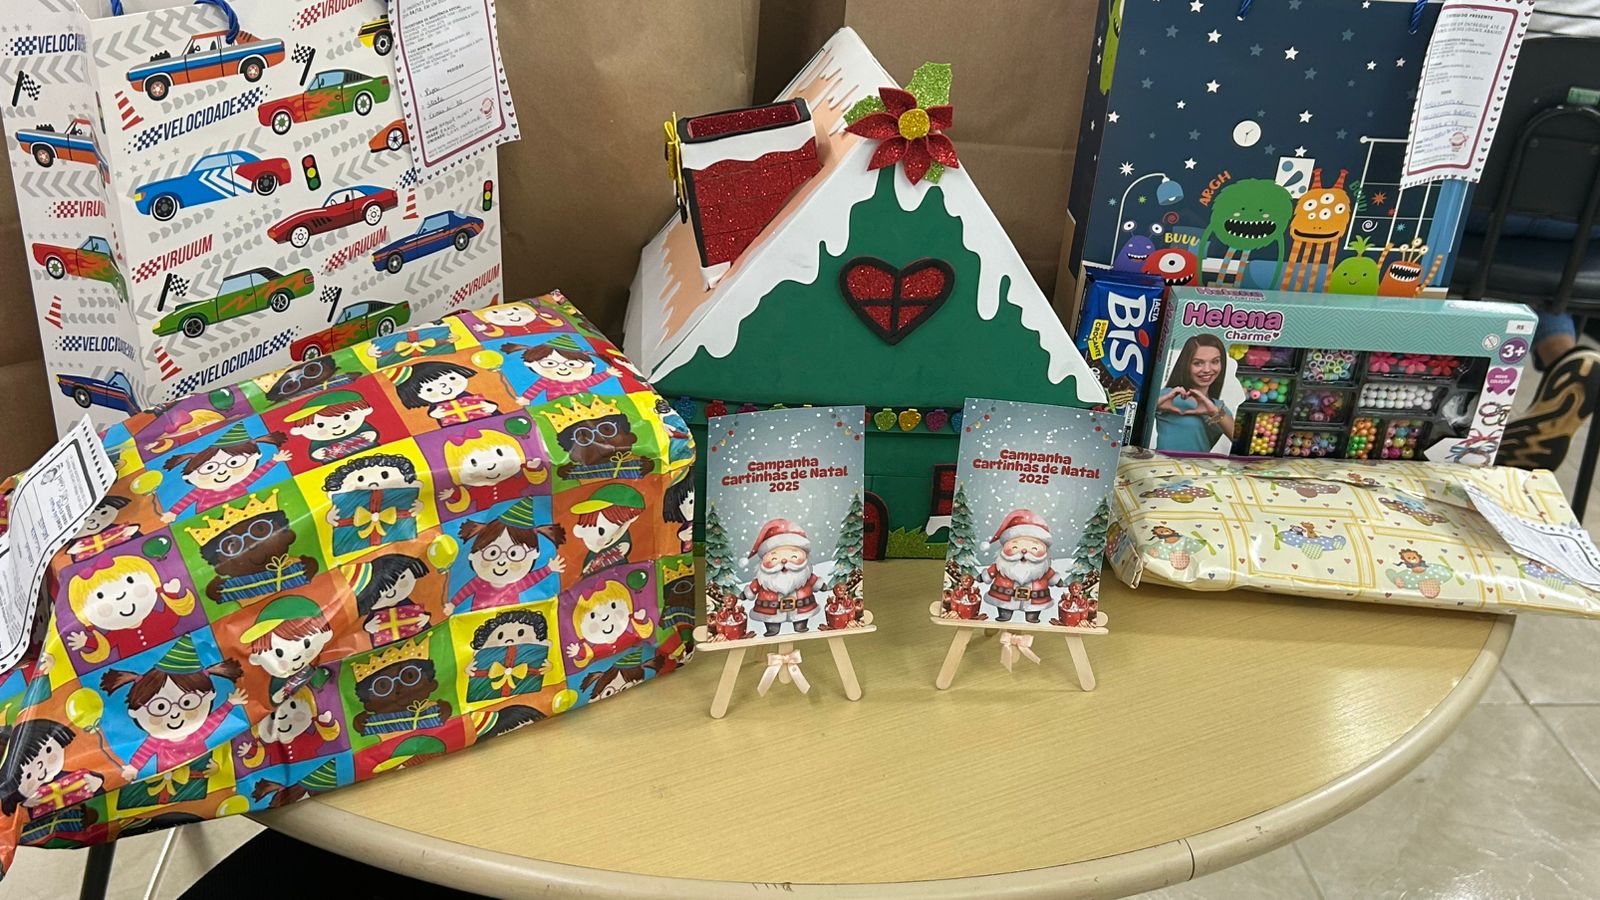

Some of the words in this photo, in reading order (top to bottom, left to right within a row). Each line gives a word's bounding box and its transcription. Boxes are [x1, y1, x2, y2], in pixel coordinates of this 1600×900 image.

[322, 0, 363, 18] VRUU
[162, 97, 238, 141] VELOCIDADE
[1200, 170, 1232, 208] ARGH
[346, 226, 388, 261] VRUUUM
[1164, 232, 1201, 246] BUUU
[161, 234, 213, 271] VRUUUM
[467, 264, 501, 296] VRUUUM
[1149, 298, 1161, 322] LACTA
[1183, 301, 1284, 331] Helena
[1092, 321, 1104, 357] CROCANTE
[1225, 330, 1272, 342] Charme
[1502, 344, 1525, 358] 3+
[200, 340, 270, 386] VELOCIDADE
[748, 456, 818, 472] Campanha
[1000, 449, 1072, 465] Campanha
[722, 470, 788, 486] Cartinhas
[790, 468, 807, 480] de
[810, 466, 848, 478] Natal
[972, 458, 1039, 473] Cartinhas
[1041, 463, 1058, 474] de
[1061, 465, 1100, 479] Natal
[1018, 473, 1050, 485] 2025
[769, 481, 800, 492] 2025
